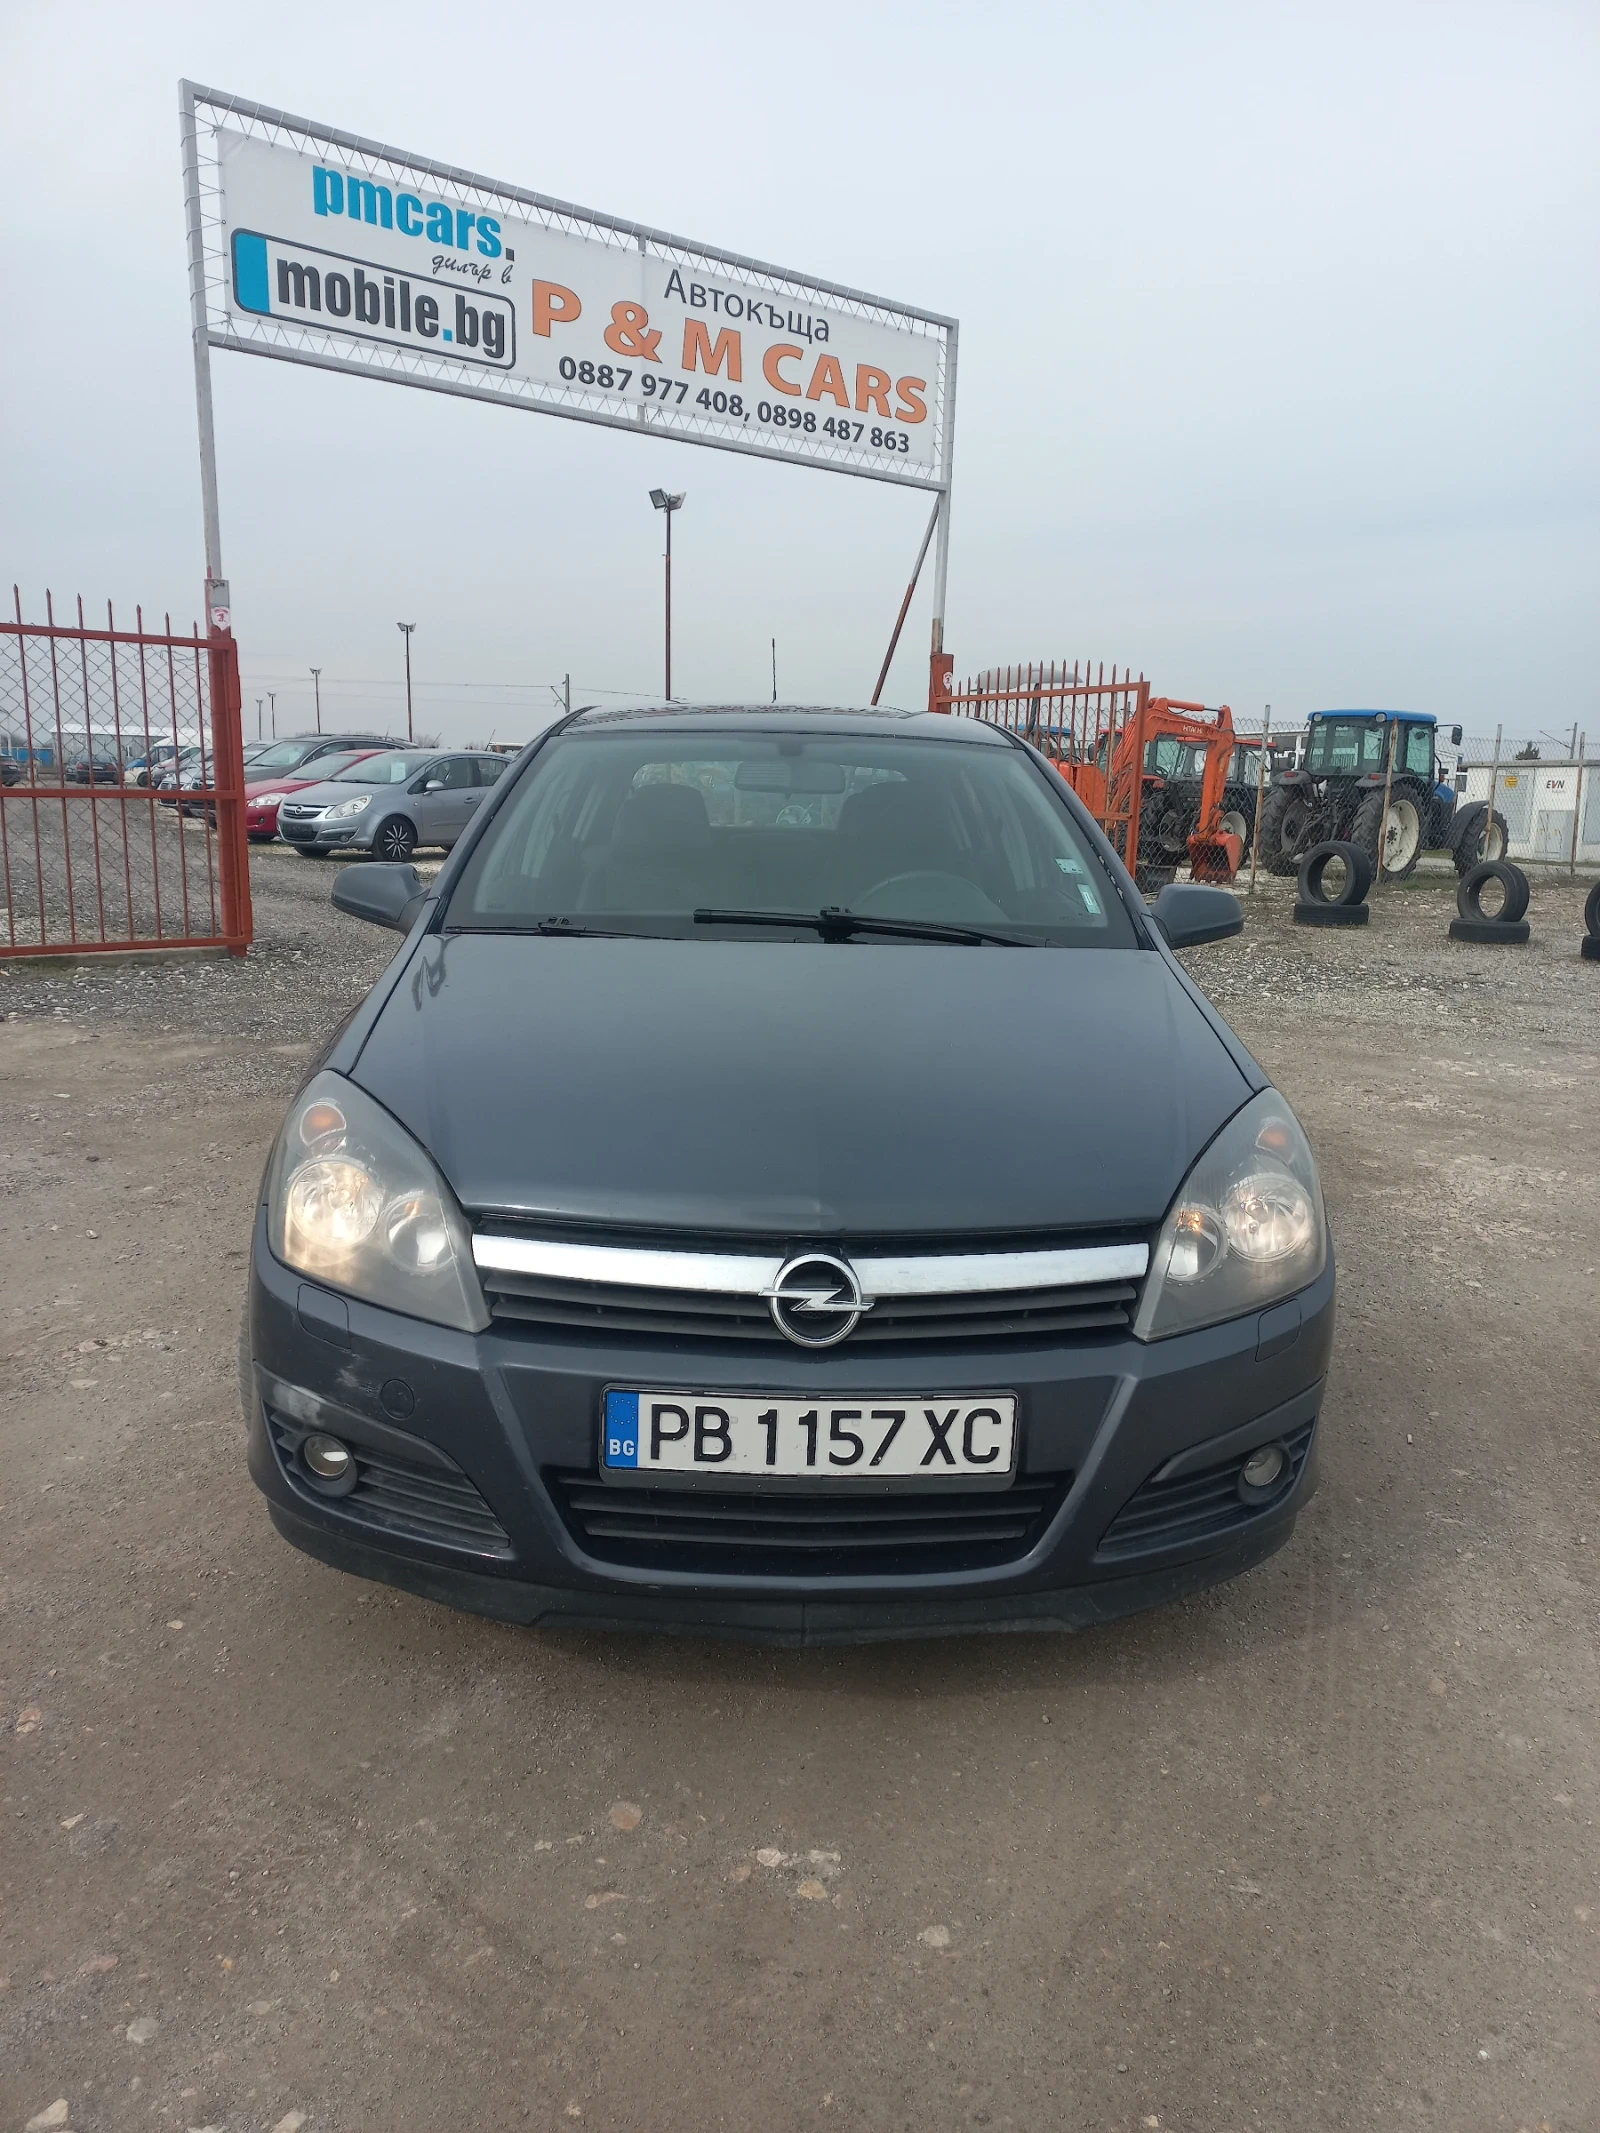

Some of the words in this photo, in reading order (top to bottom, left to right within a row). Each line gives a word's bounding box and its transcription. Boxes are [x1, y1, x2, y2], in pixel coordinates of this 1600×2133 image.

[431, 253, 492, 282] дилър
[500, 264, 512, 284] в
[276, 258, 505, 358] mobile.bg
[663, 268, 830, 344] Автокъща
[531, 278, 582, 338] P
[603, 300, 663, 364] &
[681, 317, 743, 383] M
[761, 342, 928, 424] CARS
[558, 355, 633, 392] 0887
[641, 372, 689, 404] 977
[695, 387, 750, 423] 408,
[756, 400, 817, 433] 0898
[823, 416, 865, 444] 487
[869, 425, 910, 454] 863
[1182, 725, 1202, 734] HITAHI
[1546, 780, 1565, 789] EVN
[608, 1438, 635, 1457] BG
[650, 1403, 733, 1463] PB
[757, 1408, 906, 1467] 1157
[919, 1407, 1001, 1466] XC
